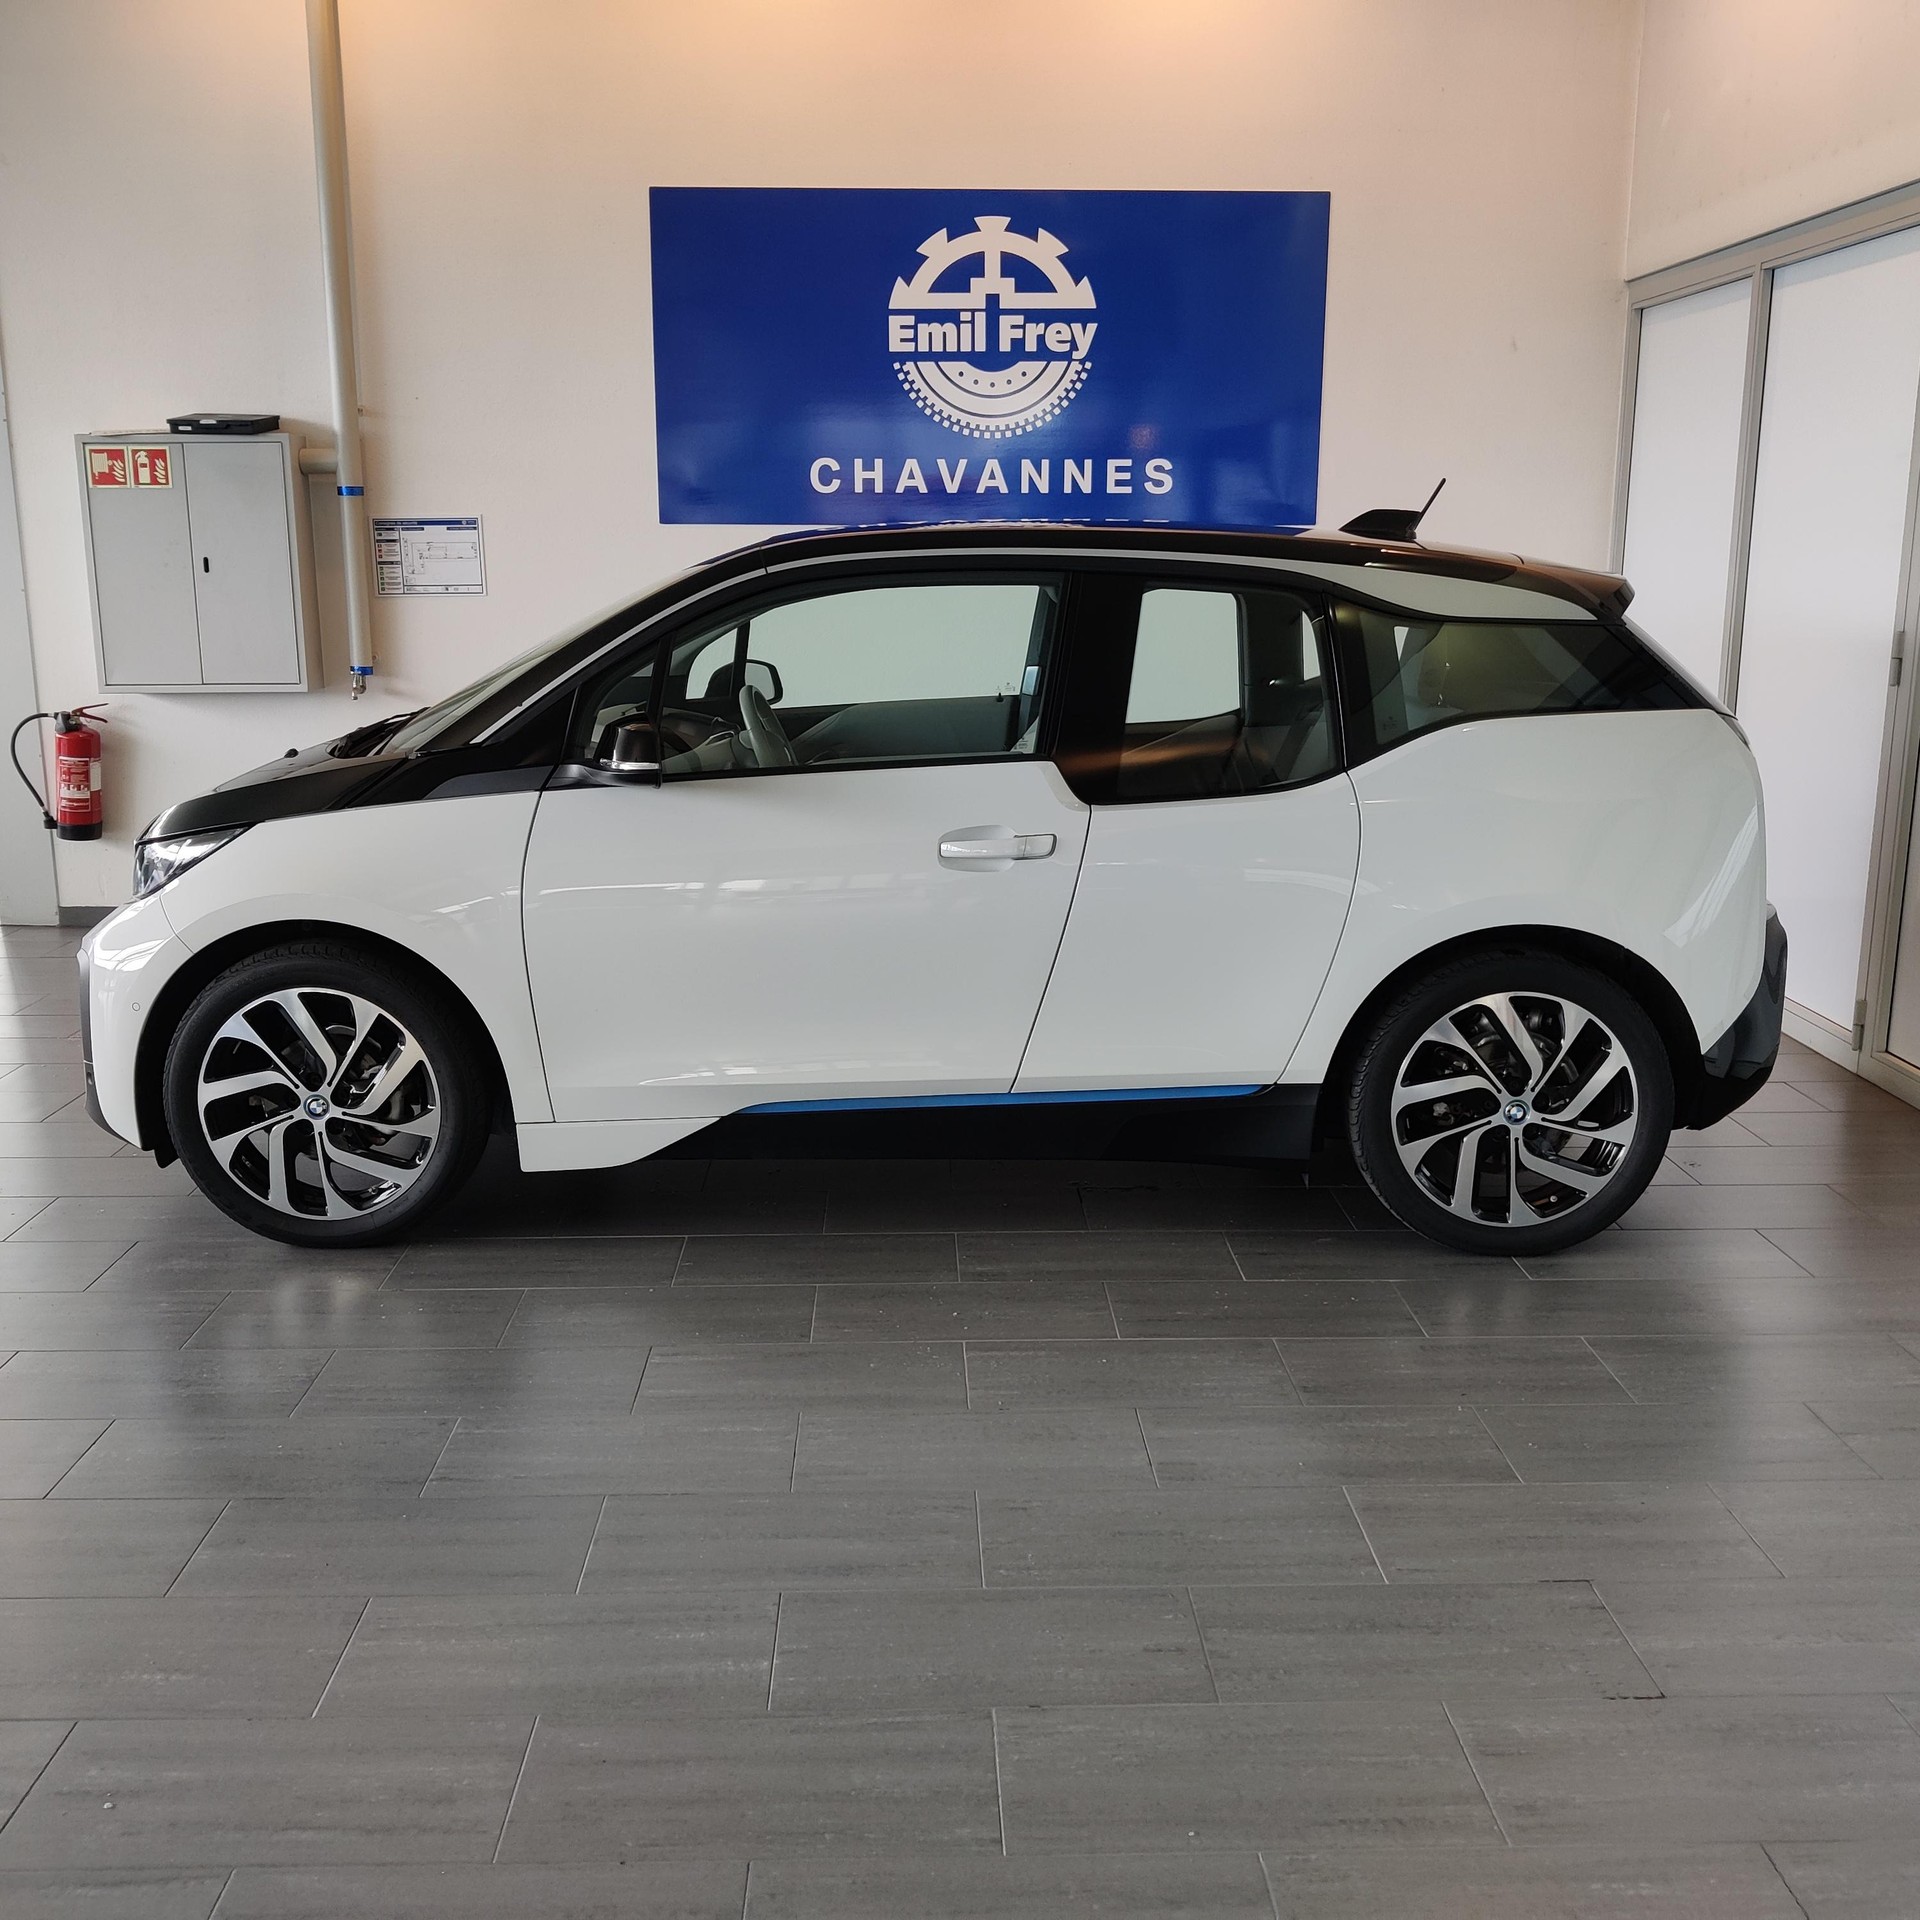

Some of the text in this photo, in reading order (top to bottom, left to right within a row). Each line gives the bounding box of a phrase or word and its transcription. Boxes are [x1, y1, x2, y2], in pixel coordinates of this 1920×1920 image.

[888, 311, 1098, 360] Emil Frey
[809, 457, 1173, 495] CHAVANNES
